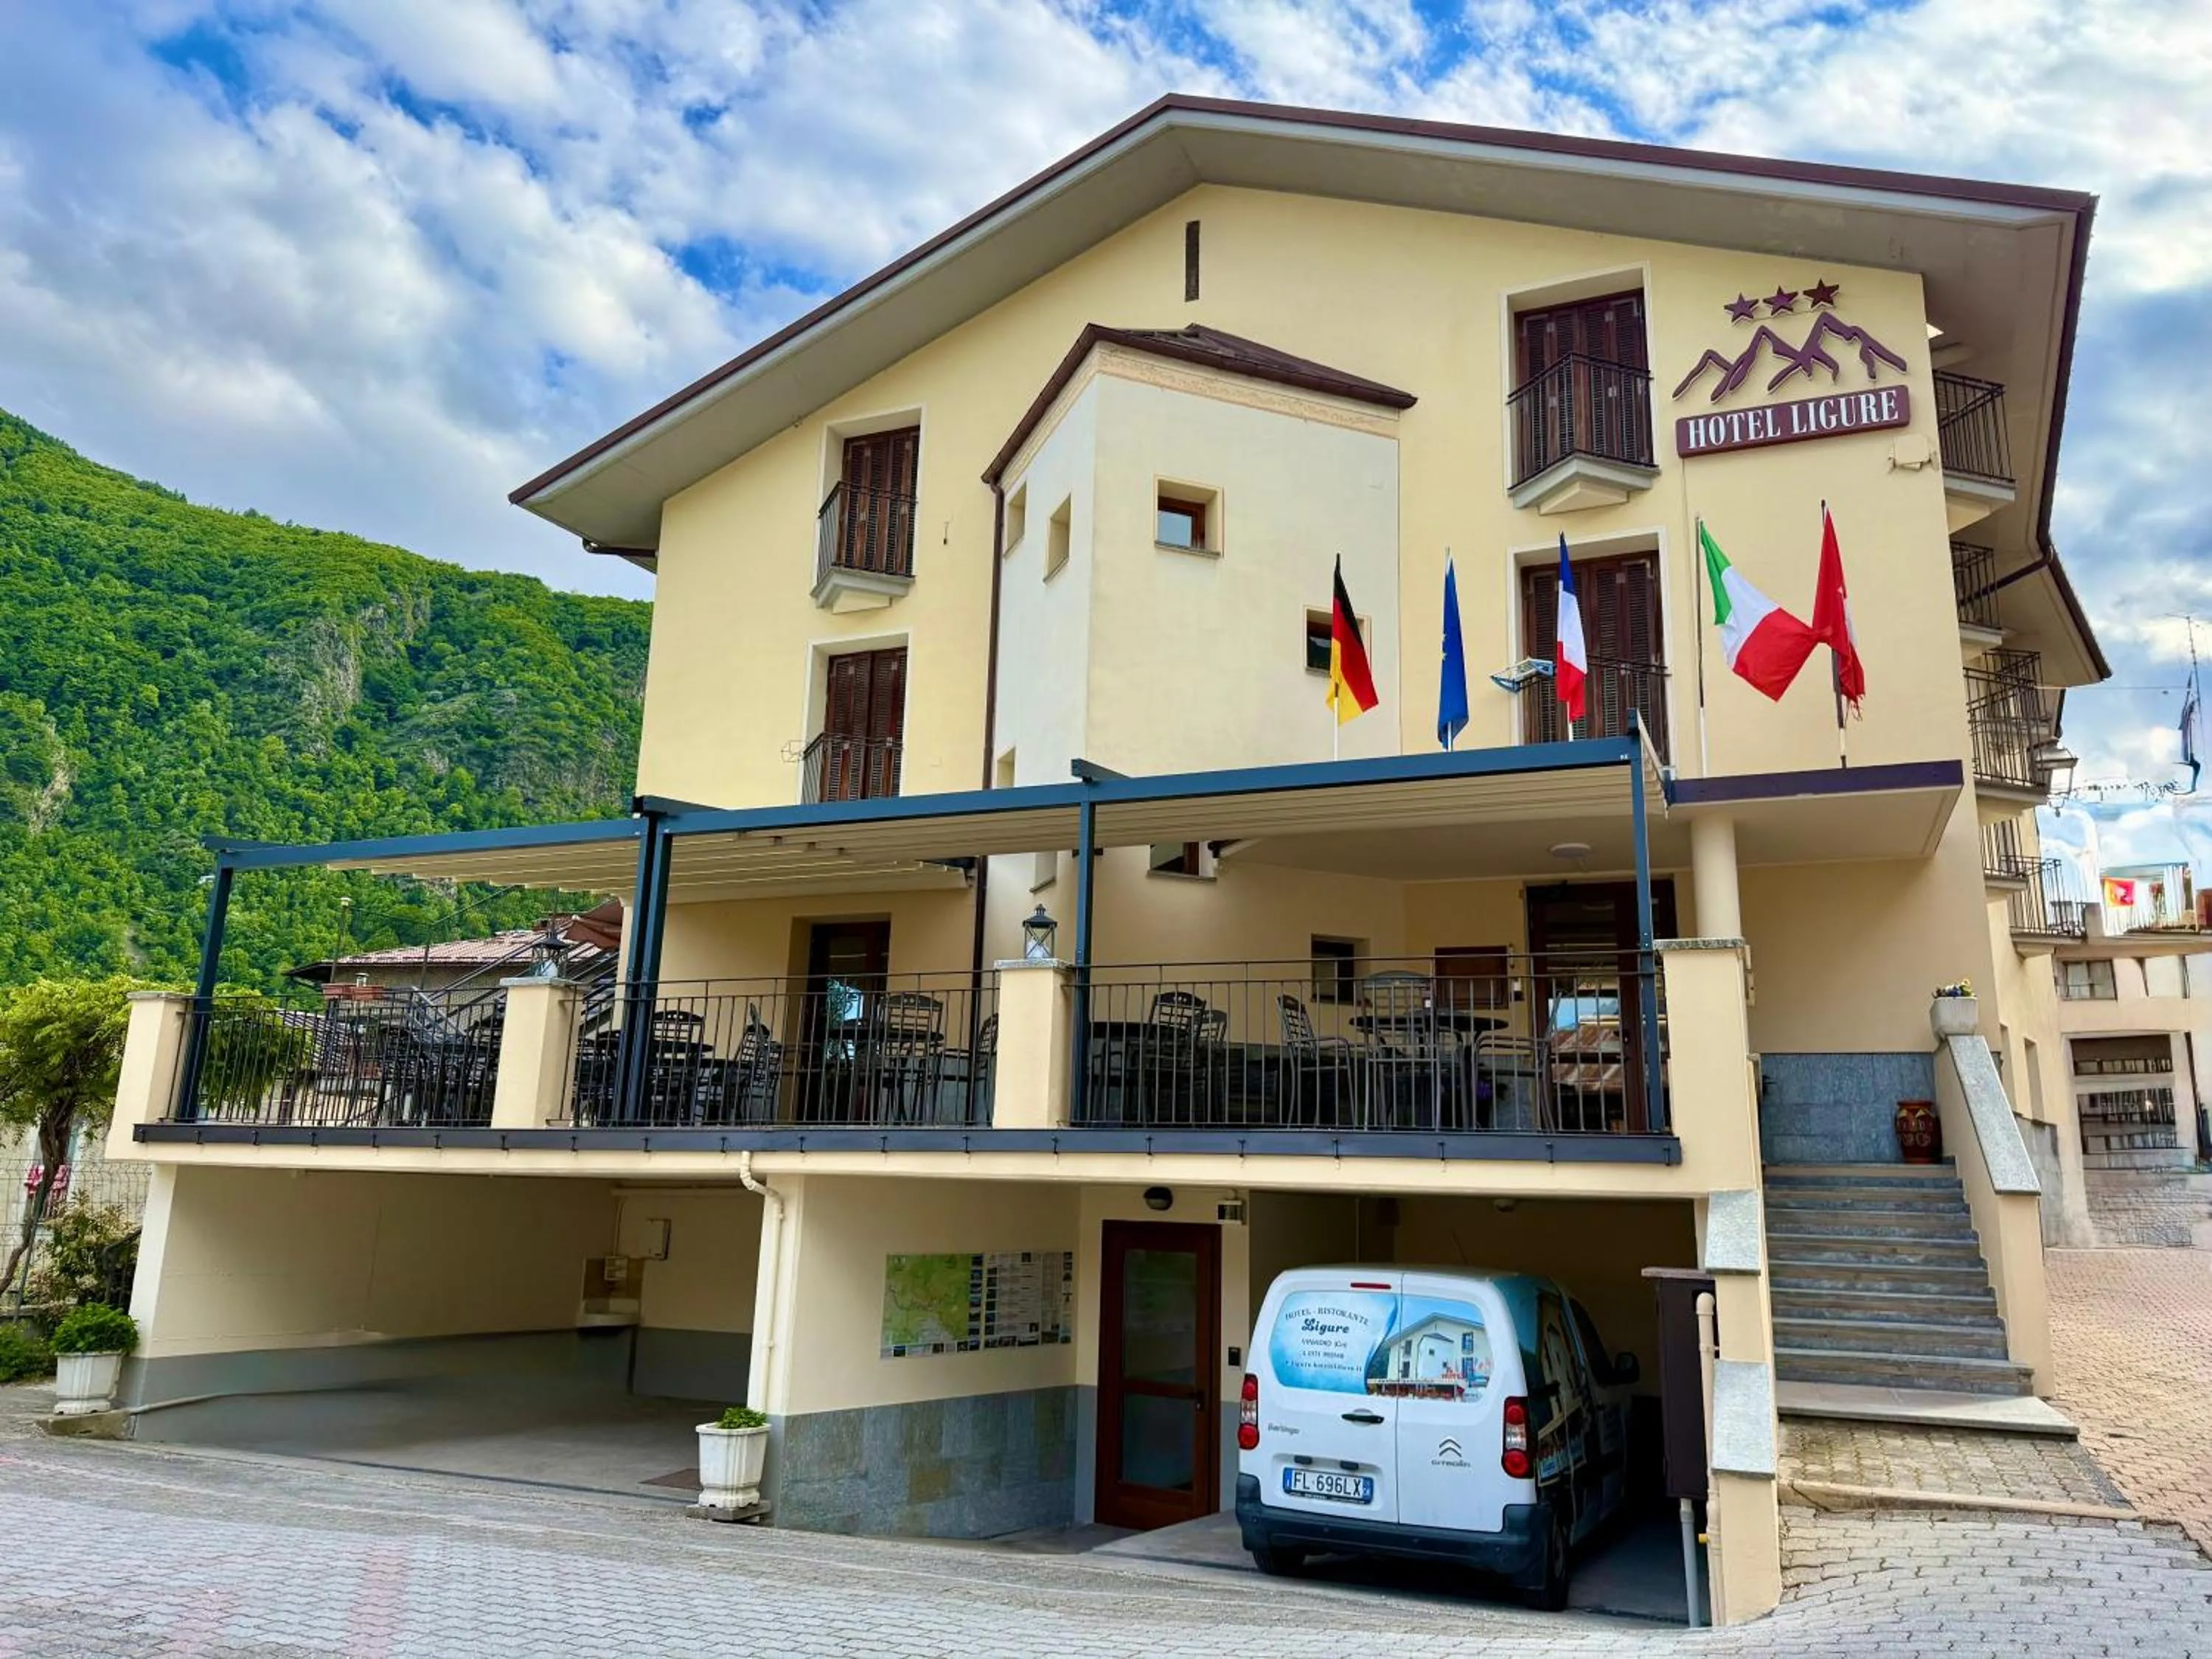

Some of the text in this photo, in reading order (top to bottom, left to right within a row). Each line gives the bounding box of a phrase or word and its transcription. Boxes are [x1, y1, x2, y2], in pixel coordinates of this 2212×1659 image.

[1686, 389, 1899, 450] HOTEL LIGURE
[1301, 1318, 1350, 1335] Ligure
